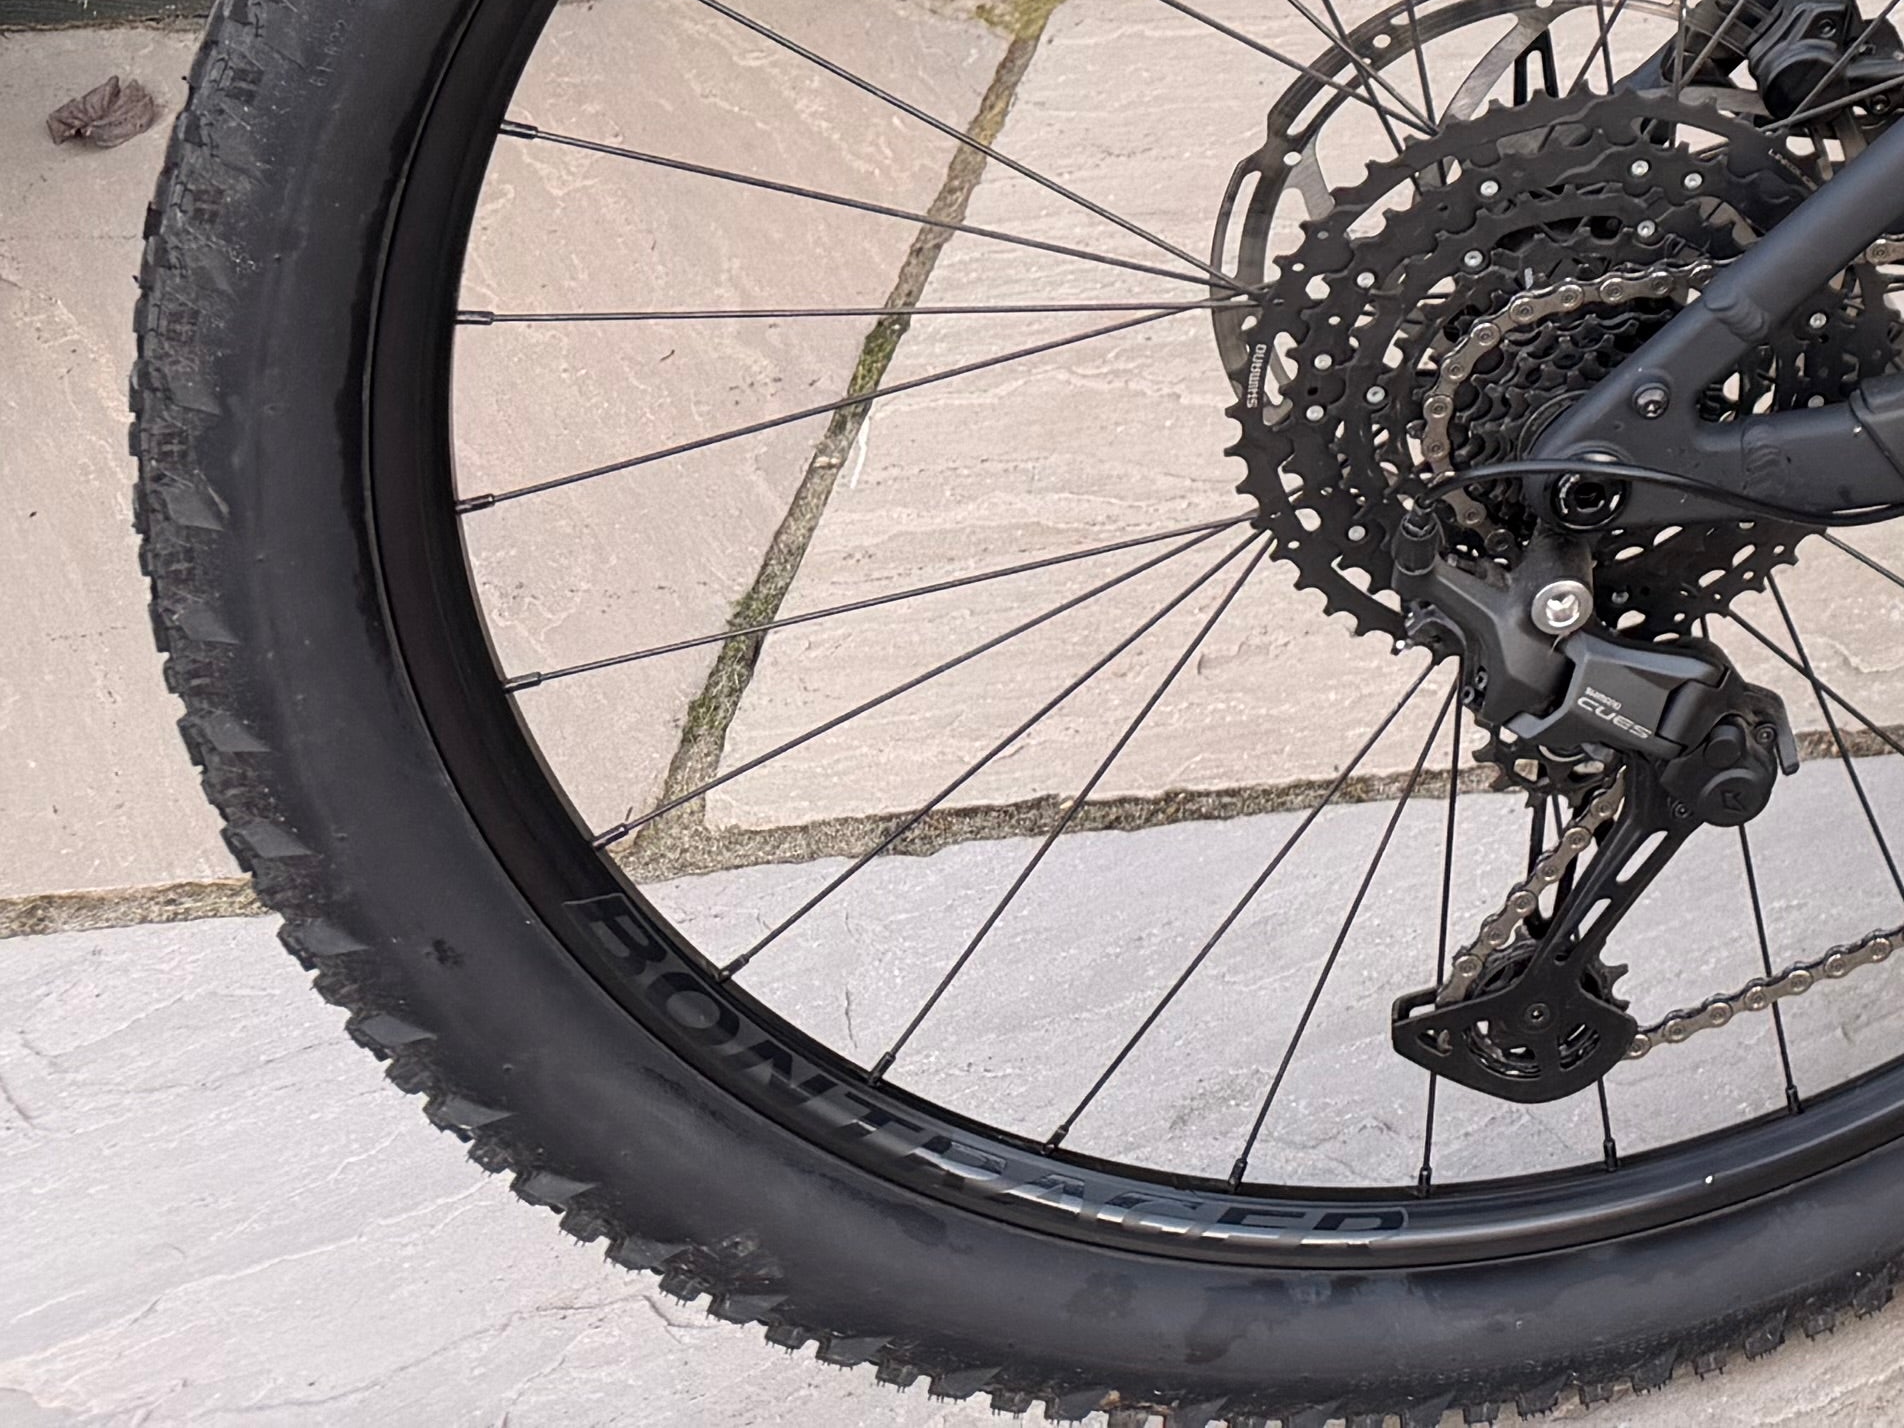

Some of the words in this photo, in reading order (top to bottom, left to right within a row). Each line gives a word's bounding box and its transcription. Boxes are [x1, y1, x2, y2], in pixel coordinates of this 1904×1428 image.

[1246, 343, 1267, 409] SHIMANO
[1577, 696, 1652, 739] CUES
[566, 893, 1411, 1246] BONTRAGER
